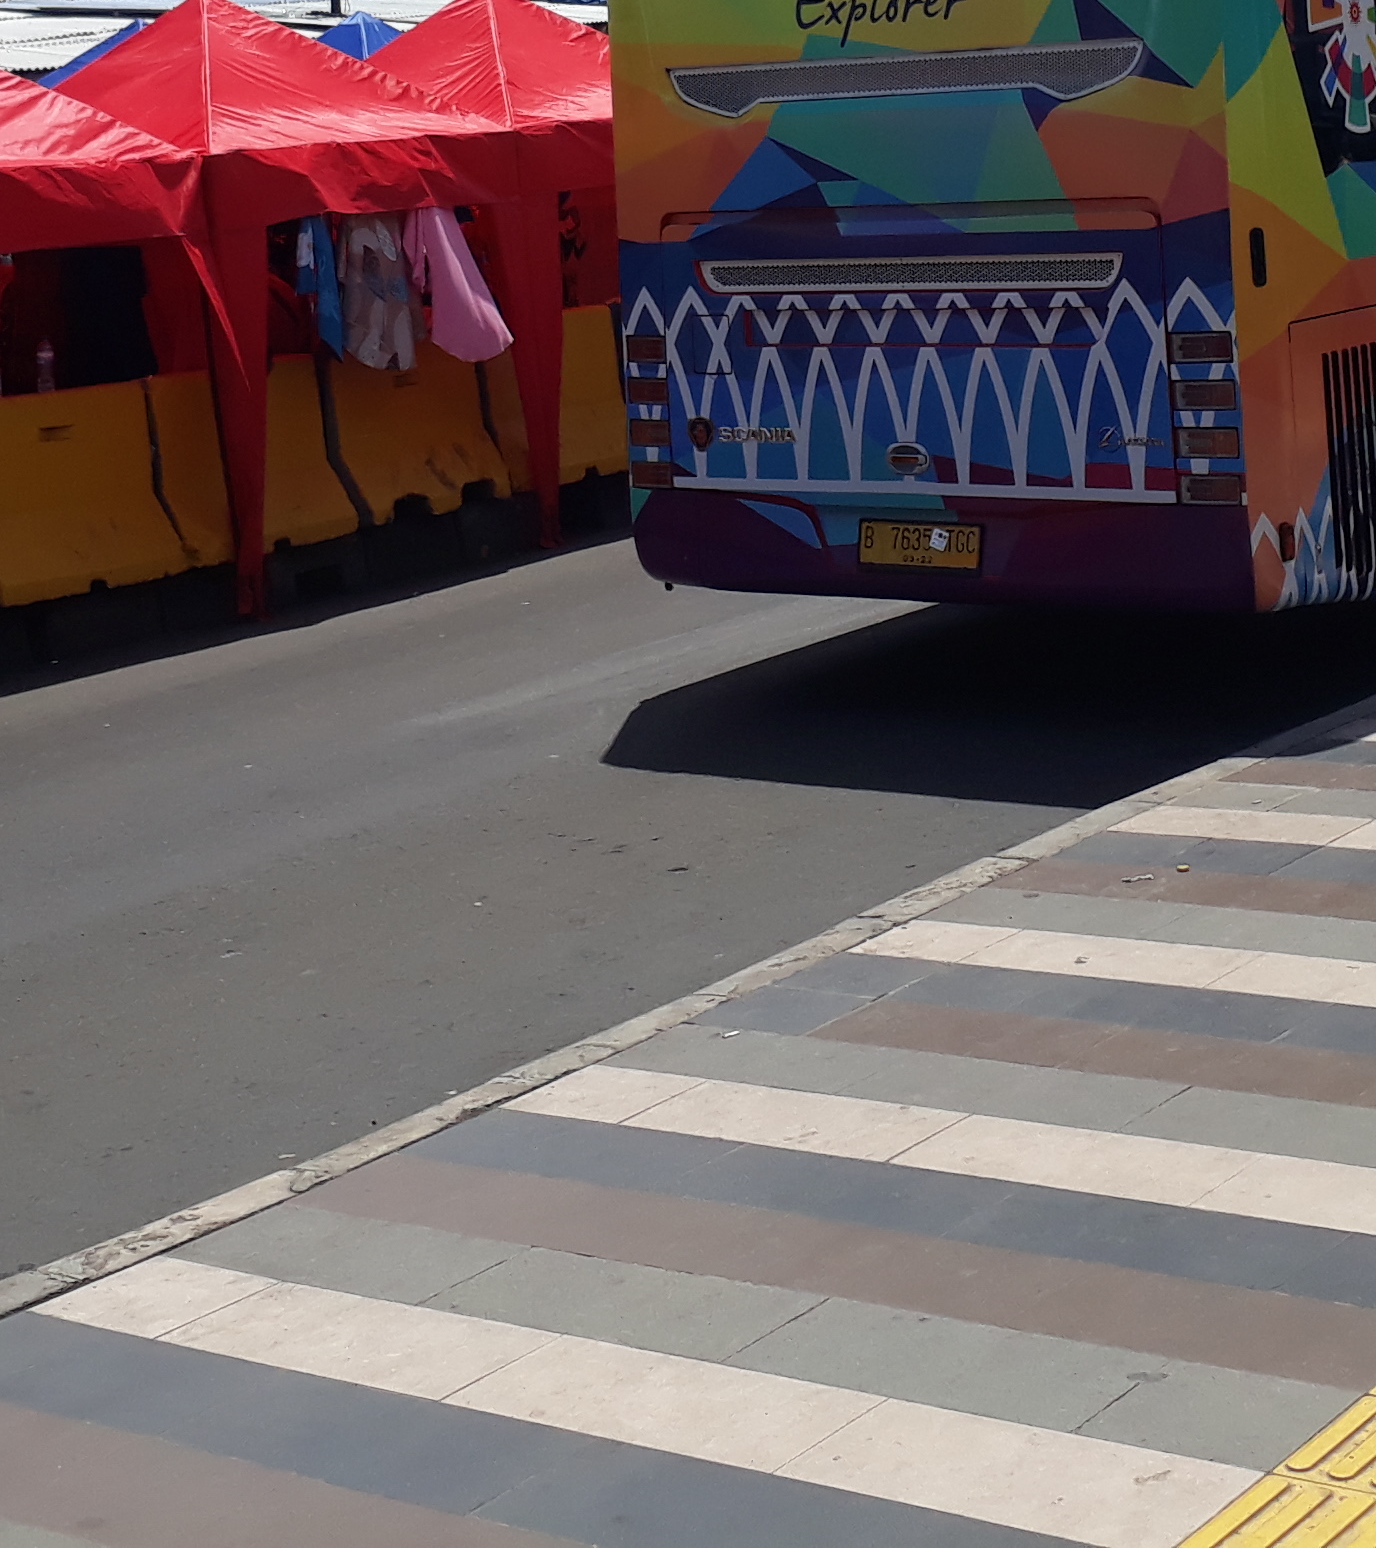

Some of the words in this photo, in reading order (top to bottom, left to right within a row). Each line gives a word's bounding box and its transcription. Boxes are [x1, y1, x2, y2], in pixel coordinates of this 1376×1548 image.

[718, 426, 797, 443] SCANIA
[864, 525, 875, 549] B
[891, 526, 933, 551] 7635
[946, 529, 976, 553] TGC
